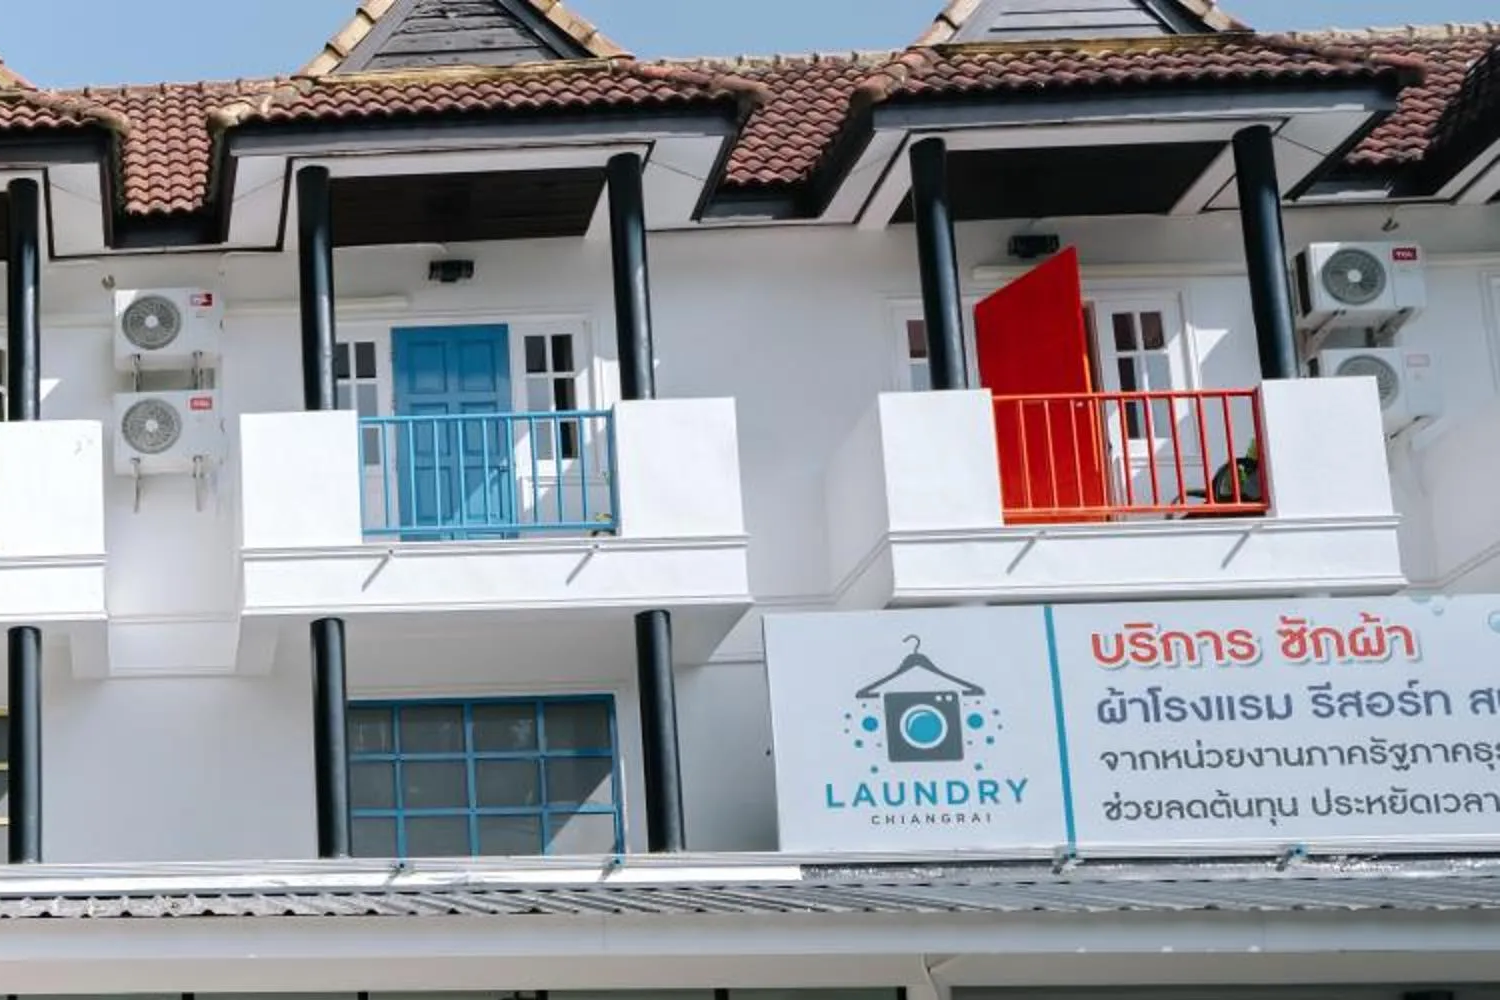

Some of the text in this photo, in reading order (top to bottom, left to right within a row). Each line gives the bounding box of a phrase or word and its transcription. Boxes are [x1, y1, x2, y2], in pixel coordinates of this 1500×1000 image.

[1091, 612, 1417, 665] บริการ ซักผ้า
[1097, 679, 1500, 724] ผ้าโรงแรม รีสอร์ท ส
[1100, 736, 1500, 772] จากหน่วยงานภาครัฐภาคธุ
[825, 777, 1029, 808] LAUNDRY
[1102, 790, 1300, 826] ช่วยลดต้นทุน
[871, 813, 992, 826] CHIANGRAI
